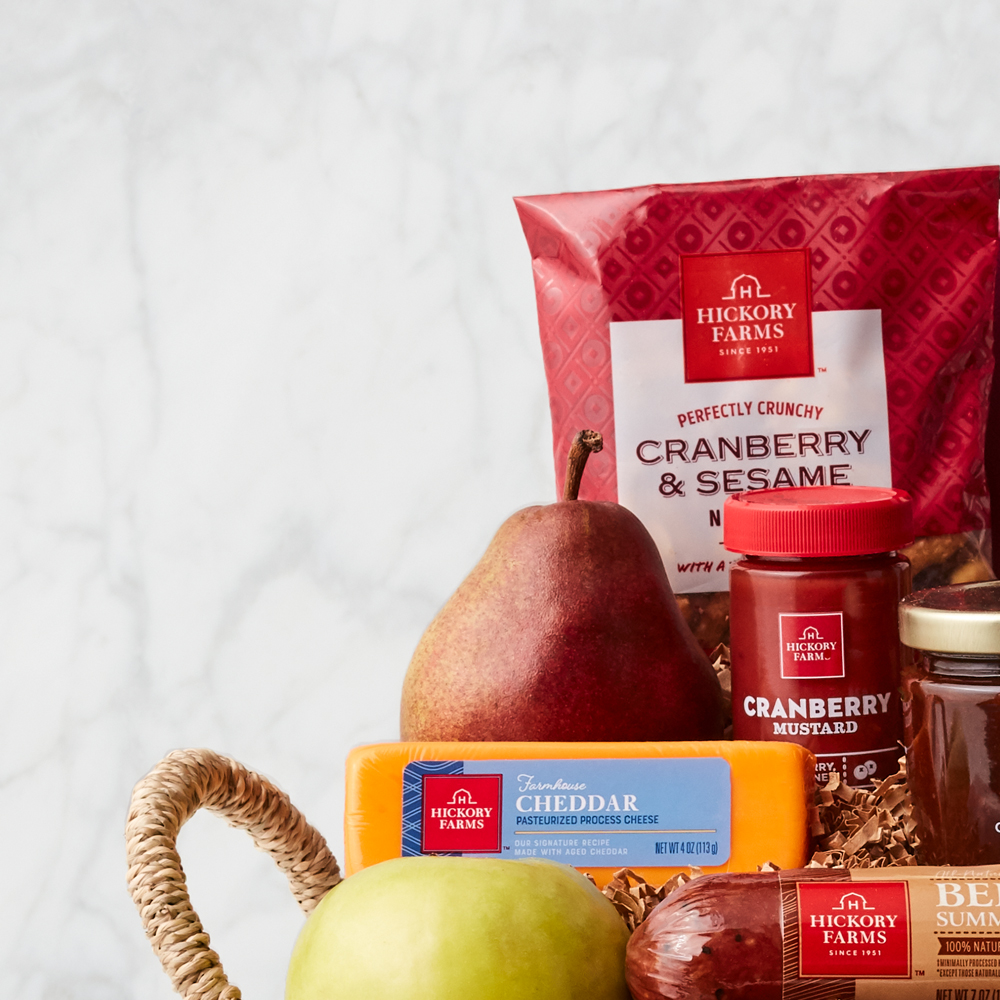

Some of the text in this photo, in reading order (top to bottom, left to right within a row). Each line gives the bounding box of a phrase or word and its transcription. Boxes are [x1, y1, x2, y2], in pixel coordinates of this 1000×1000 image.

[740, 285, 751, 298] H
[697, 302, 797, 324] HICKORY
[712, 323, 784, 343] FARMS
[719, 345, 779, 356] SINCE 1951
[677, 401, 824, 428] PERFECTLY CRUNCHY
[636, 429, 872, 465] CRANBERRY
[659, 464, 853, 498] & SESAME
[677, 560, 725, 573] WITH A
[787, 641, 837, 652] HICKORY
[744, 692, 892, 719] CRANBERRY
[773, 721, 859, 736] MUSTARD
[517, 774, 587, 793] Farmhouse
[458, 796, 466, 805] H
[516, 794, 640, 813] CHEDDAR
[431, 808, 493, 818] HICKORY
[439, 819, 485, 830] FARMS
[516, 815, 660, 826] PASTEURIZED PROCESS CHEESE
[514, 839, 610, 848] OUR SIGNATURE RECIPE
[655, 841, 719, 856] NET WT 4 OZ (113 g)
[541, 848, 562, 856] WITH
[566, 848, 587, 856] AGED
[590, 848, 628, 856] CHEDDAR
[849, 901, 859, 910] H
[810, 915, 898, 928] HICKORY
[823, 930, 887, 944] FARMS
[945, 941, 972, 953] 100%
[969, 959, 998, 967] PROCESSED
[959, 969, 974, 978] THOSE
